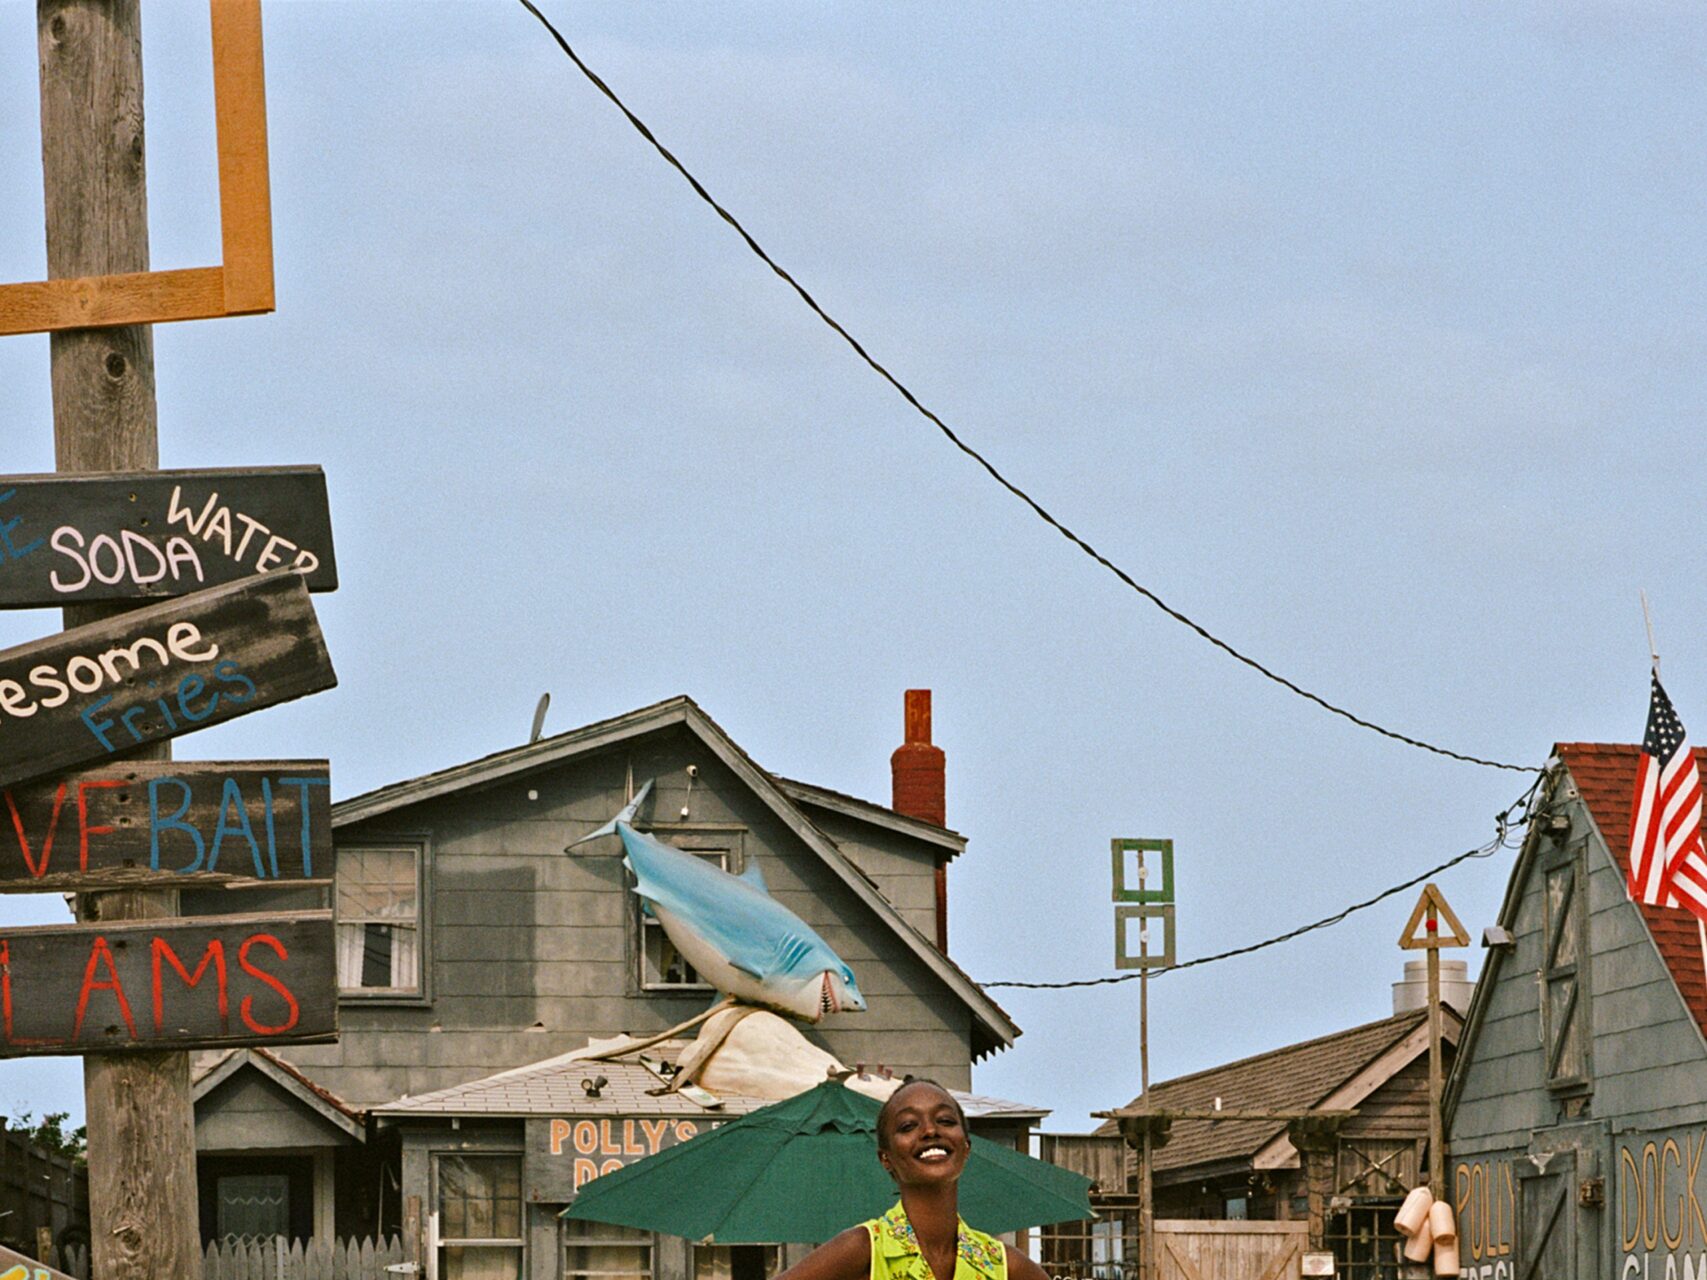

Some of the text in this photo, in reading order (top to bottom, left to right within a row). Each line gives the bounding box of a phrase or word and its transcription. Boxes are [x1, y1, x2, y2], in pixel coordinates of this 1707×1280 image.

[50, 525, 204, 593] SODA
[80, 659, 257, 753] Fries
[148, 776, 330, 878] BAIT
[550, 1118, 699, 1156] POLLY'S
[1621, 1130, 1707, 1252] DOCK
